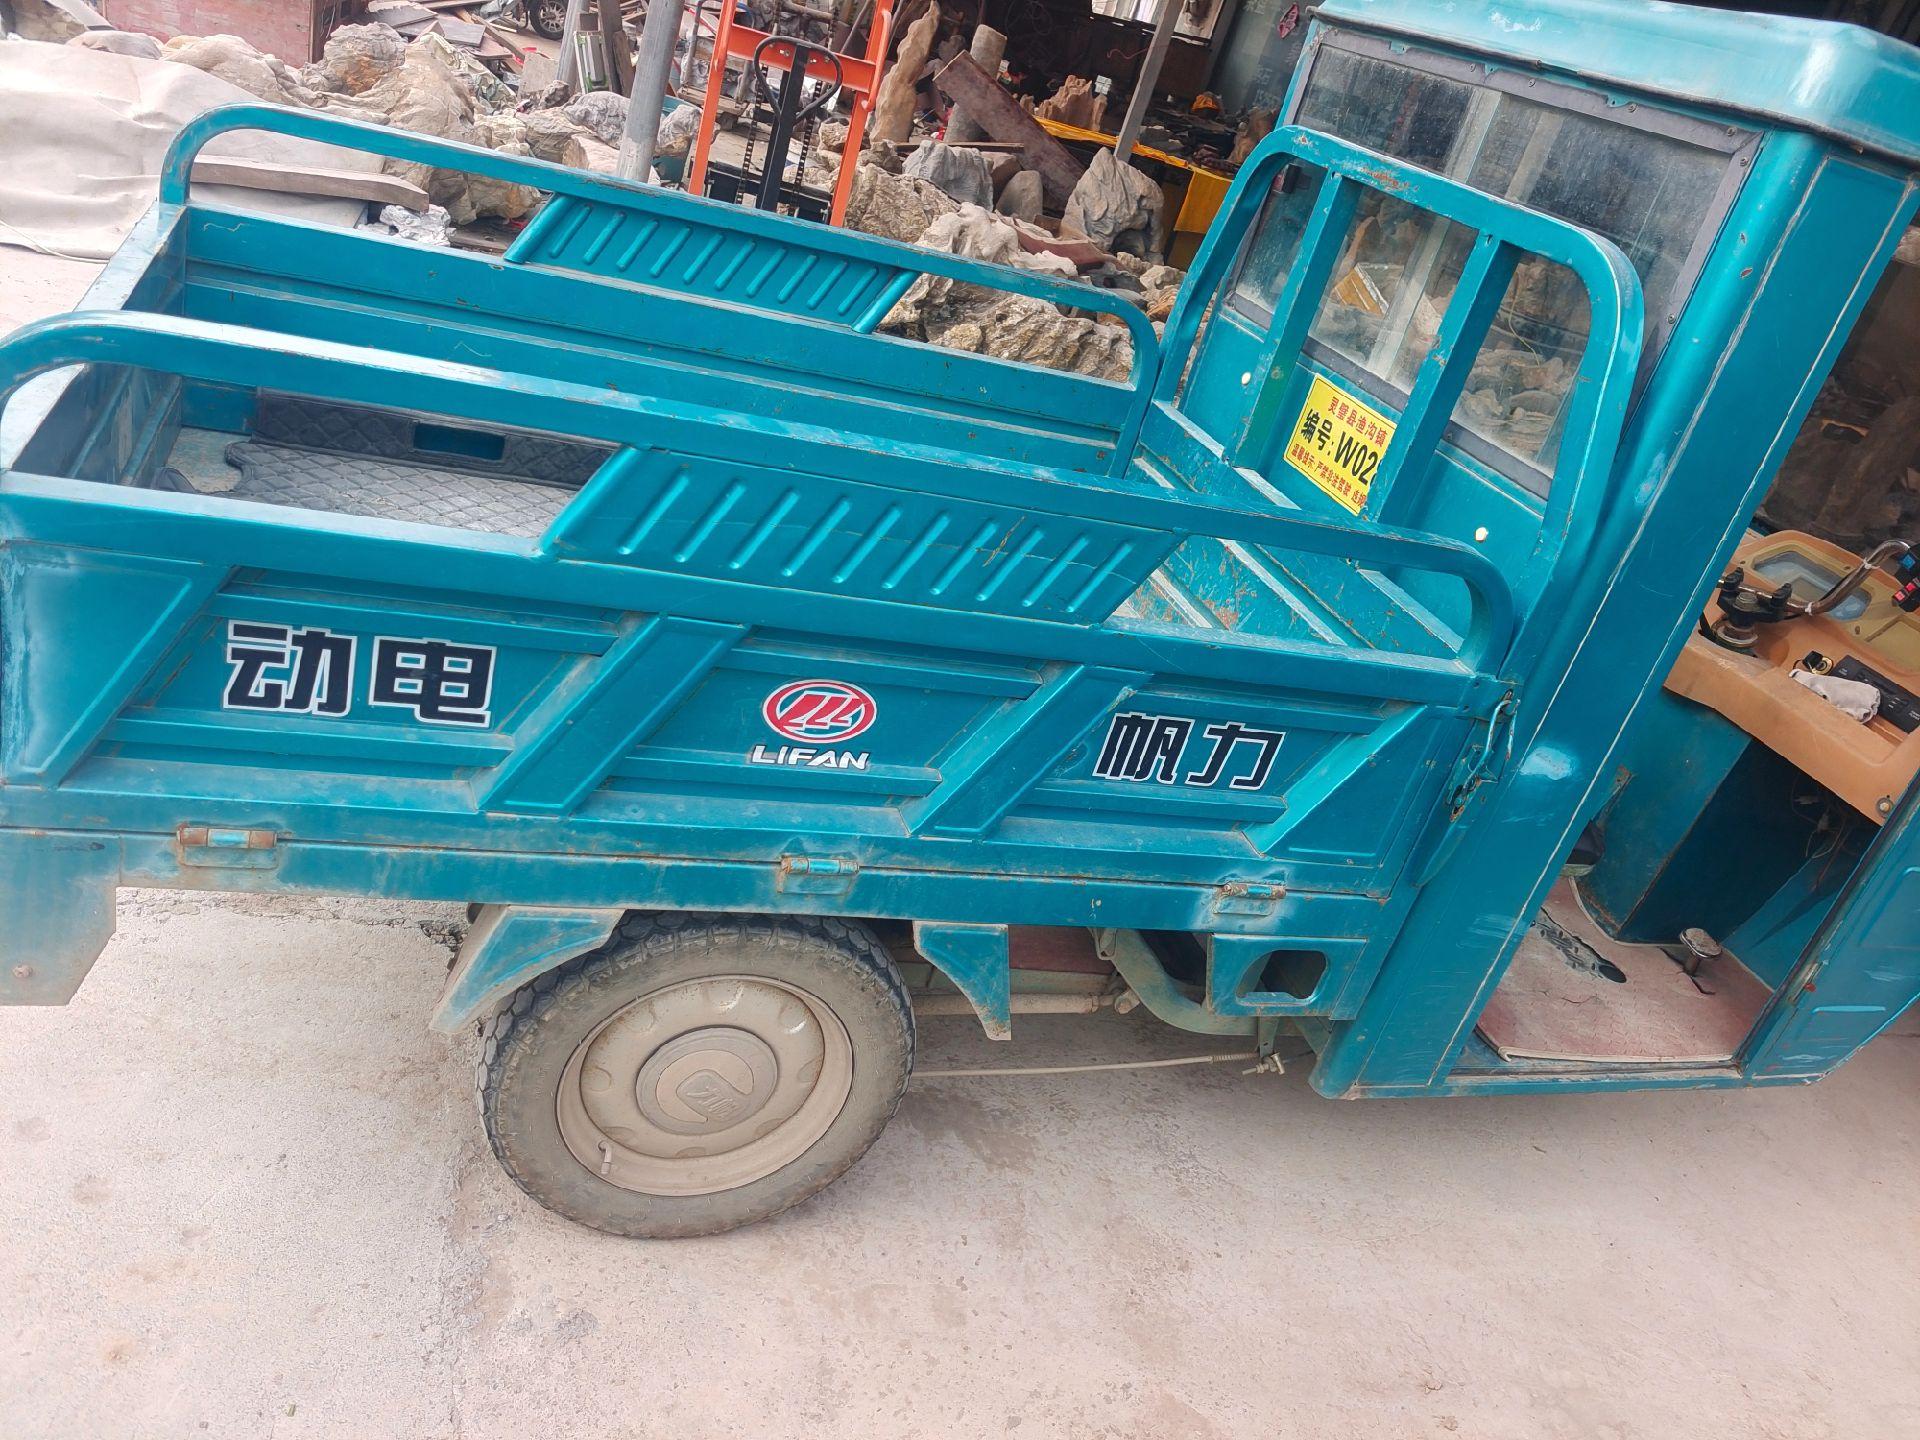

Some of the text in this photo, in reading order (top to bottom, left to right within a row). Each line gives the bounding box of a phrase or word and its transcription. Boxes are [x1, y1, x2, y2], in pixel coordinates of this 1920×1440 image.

[1301, 409, 1378, 487] 编号:W02
[752, 745, 869, 770] LIFAN
[1092, 711, 1286, 790] 帆力
